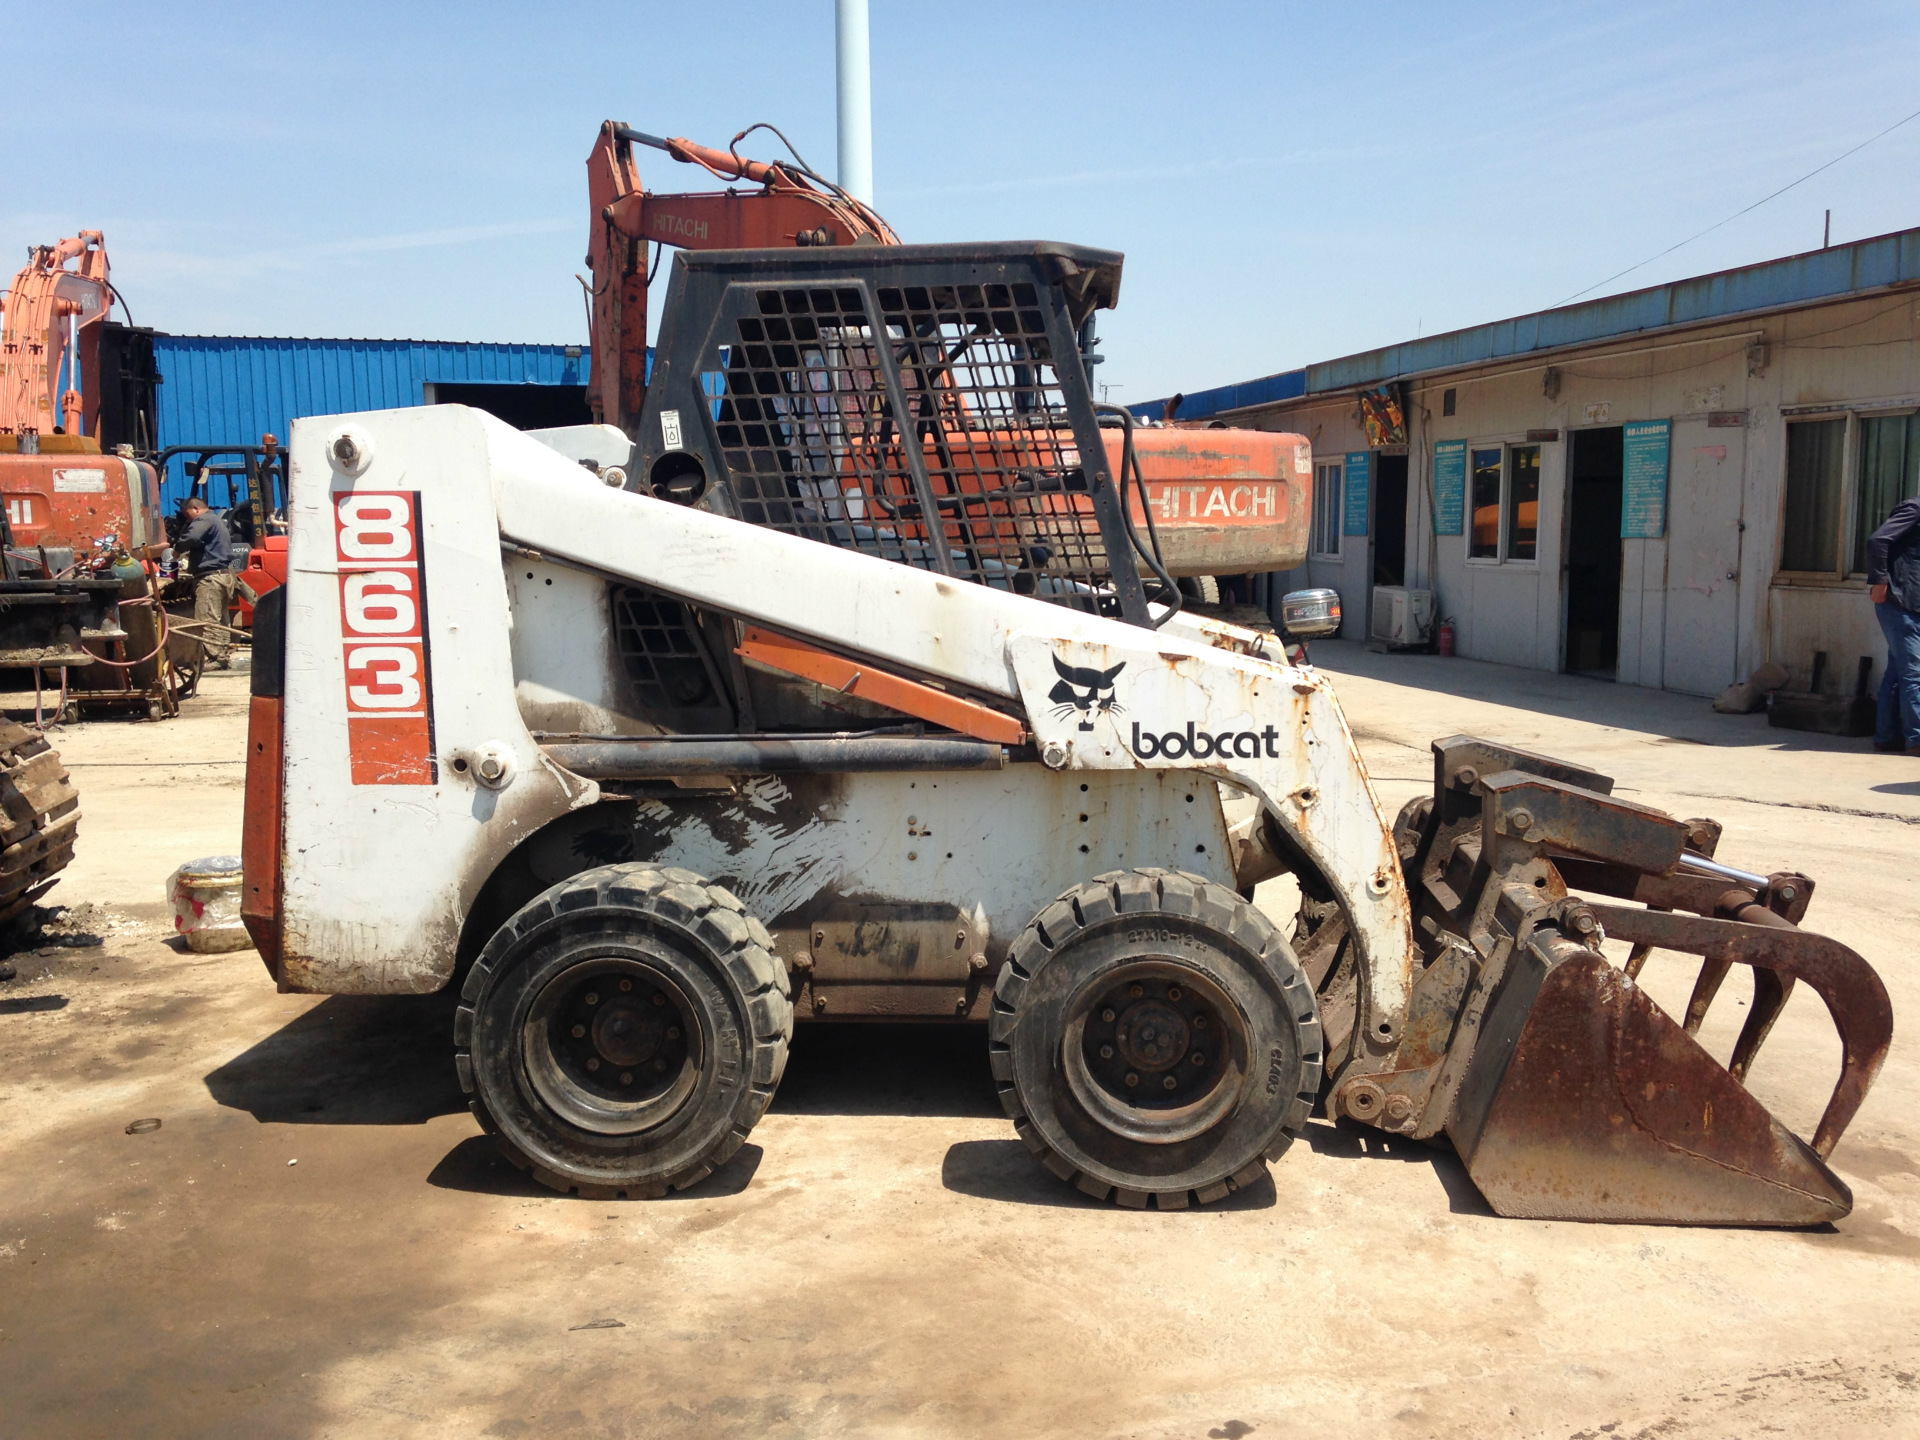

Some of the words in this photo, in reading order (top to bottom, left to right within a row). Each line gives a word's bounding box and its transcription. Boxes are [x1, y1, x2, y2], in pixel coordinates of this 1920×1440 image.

[653, 212, 708, 240] HITACHI
[1145, 486, 1276, 518] HITACHI
[338, 494, 421, 709] 863
[1132, 721, 1280, 760] bobcat
